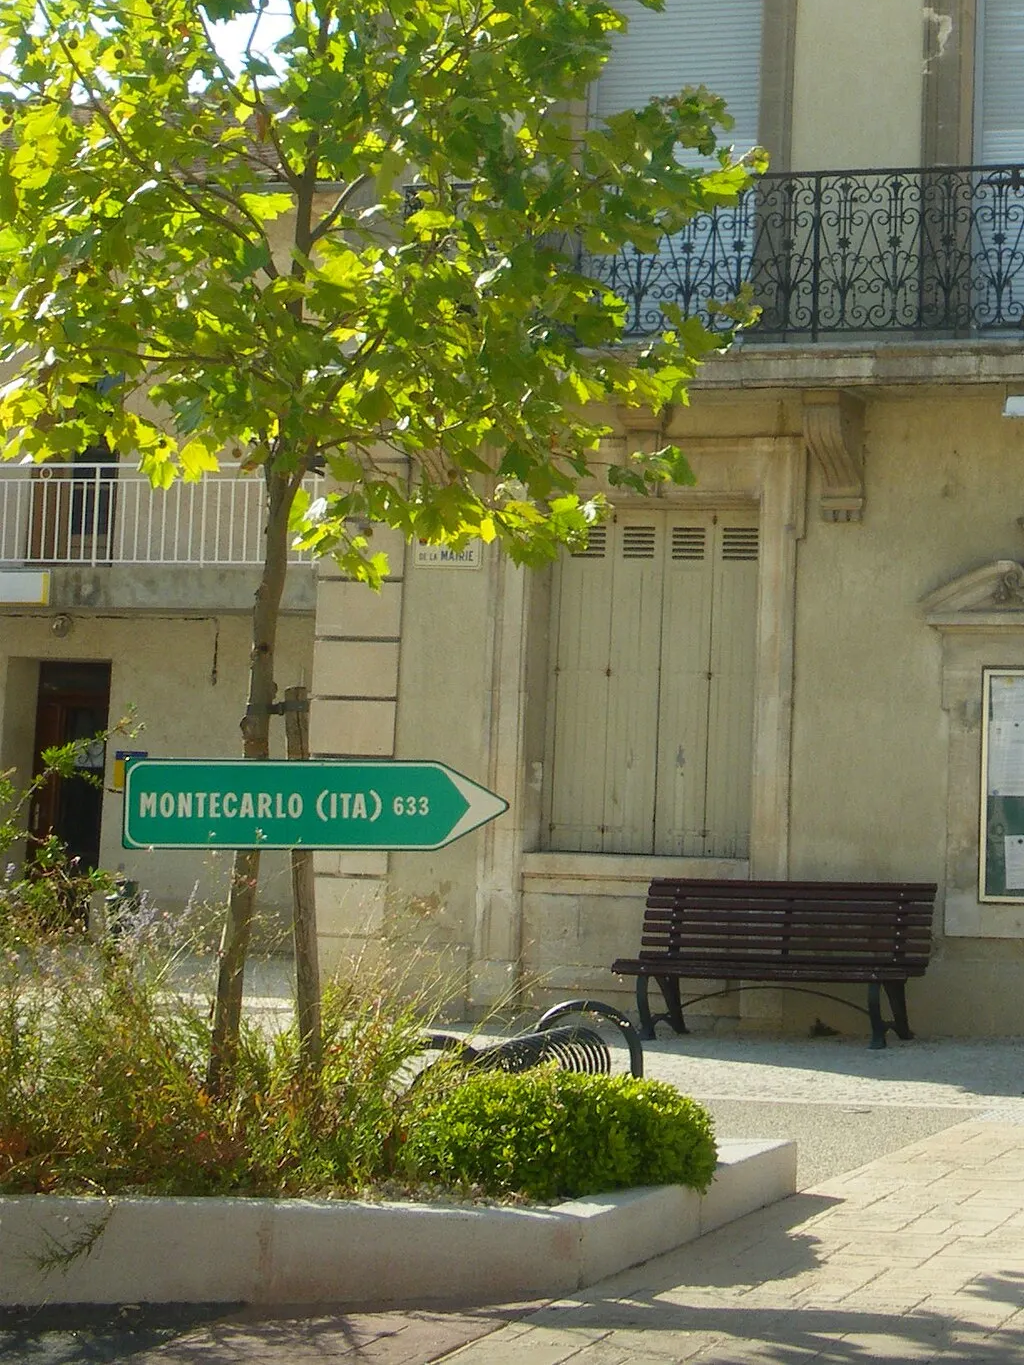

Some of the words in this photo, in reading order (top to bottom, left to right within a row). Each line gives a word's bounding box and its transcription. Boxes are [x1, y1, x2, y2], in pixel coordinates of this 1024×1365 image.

[440, 550, 474, 562] MAIRIE
[138, 791, 304, 819] MONTECARLO
[316, 789, 382, 822] (ITA)
[392, 796, 430, 816] 633
